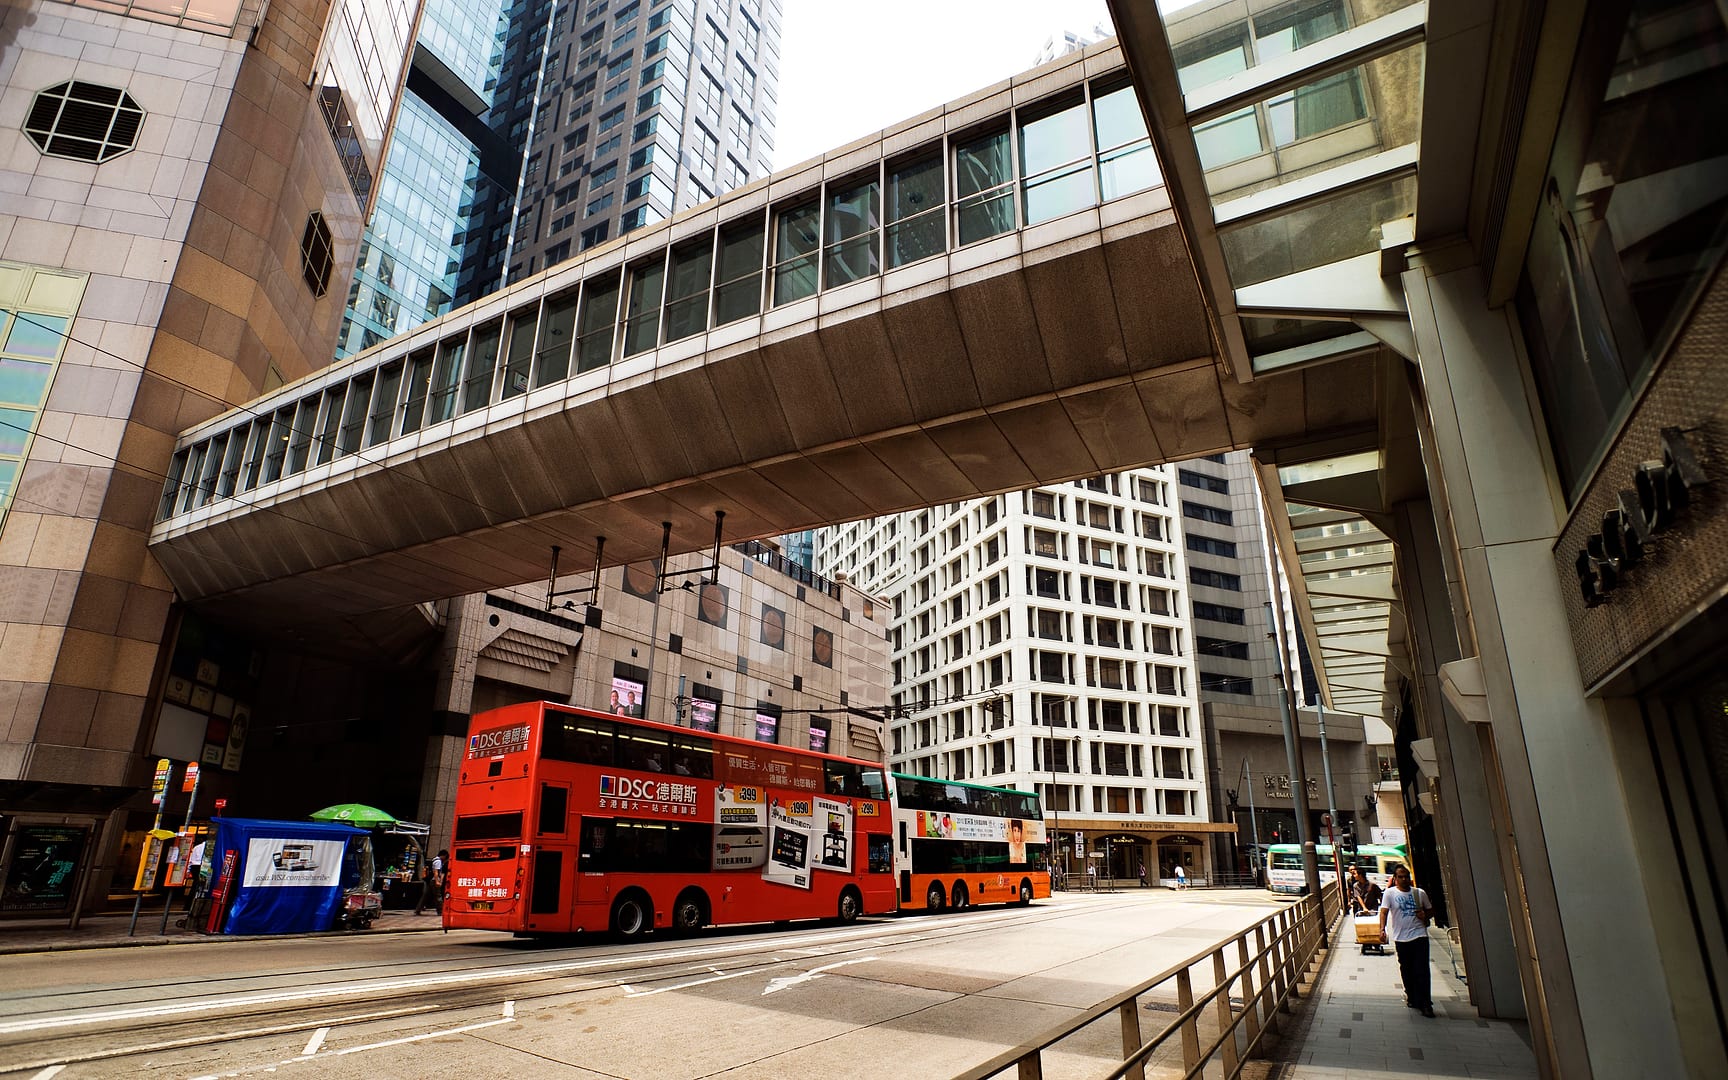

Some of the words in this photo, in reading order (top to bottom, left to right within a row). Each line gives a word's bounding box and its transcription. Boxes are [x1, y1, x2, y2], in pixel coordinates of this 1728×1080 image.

[479, 731, 502, 749] DSC
[618, 777, 655, 800] DSC
[656, 782, 697, 804] 德爾斯
[739, 787, 757, 801] $399
